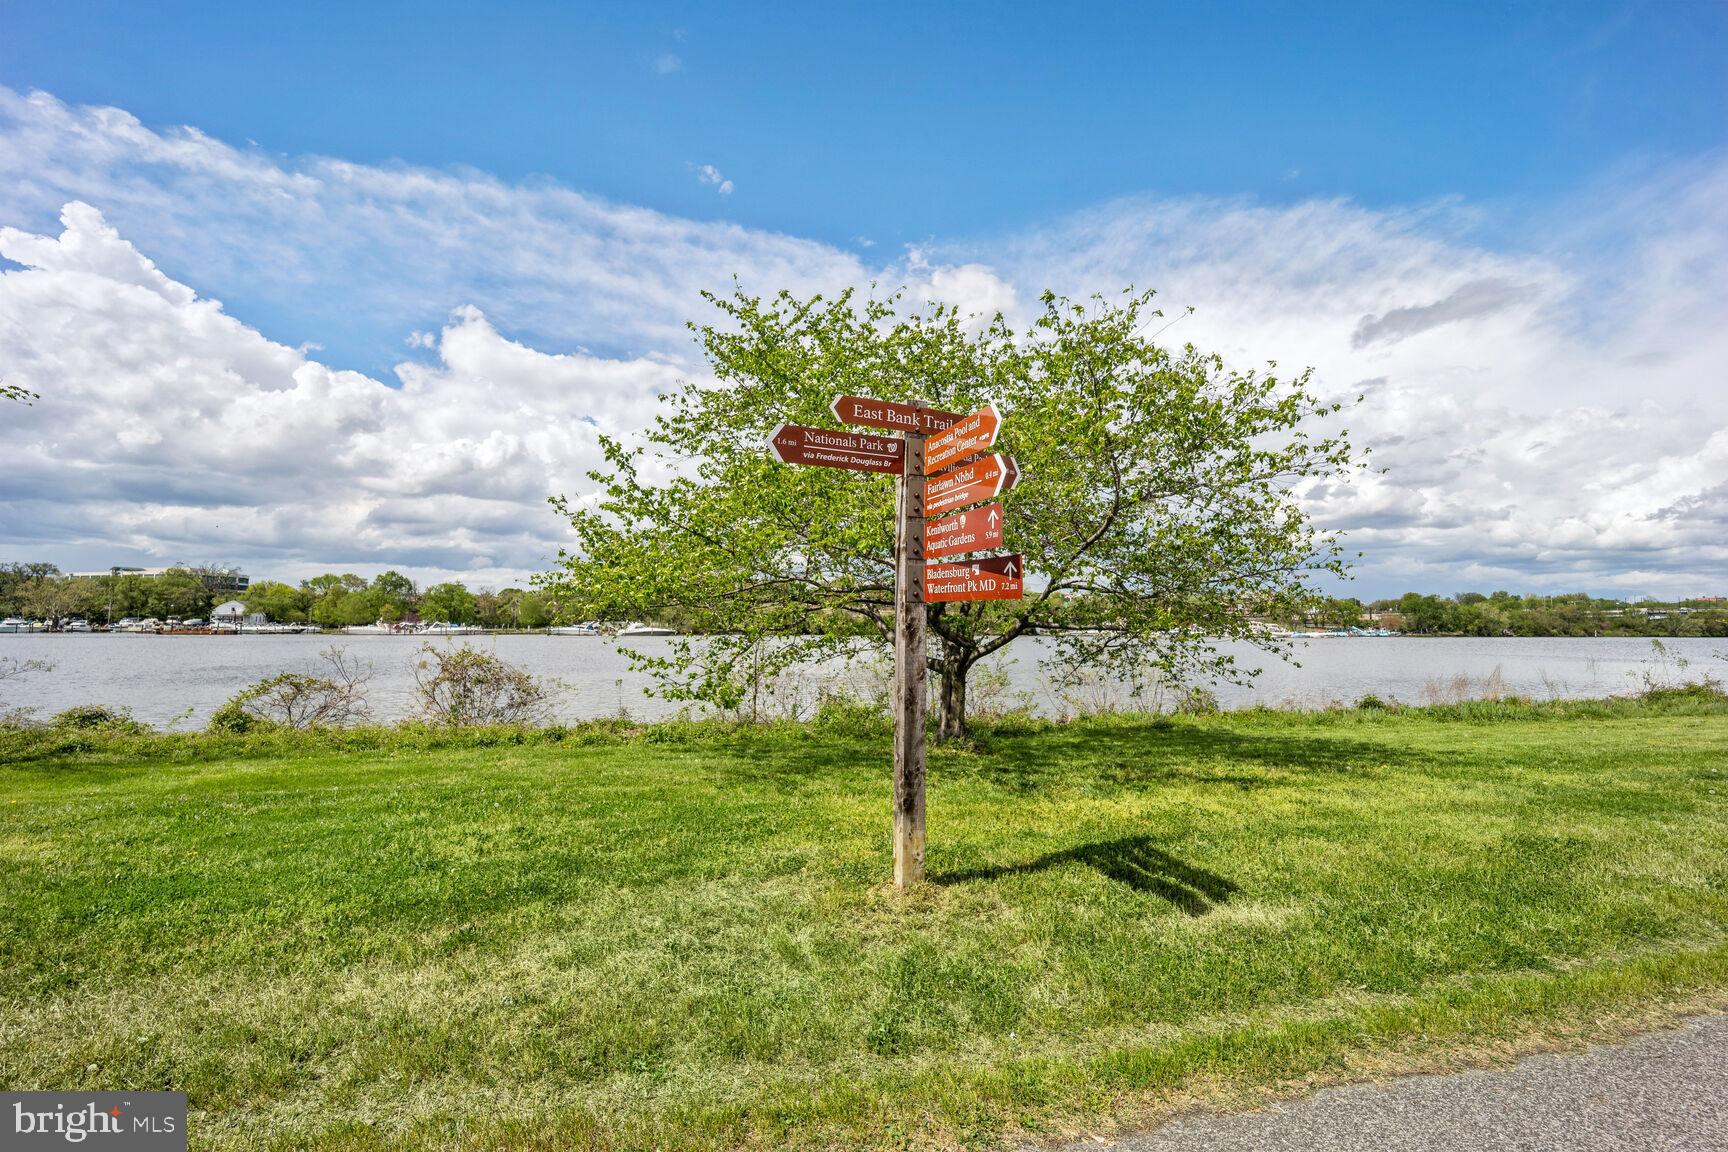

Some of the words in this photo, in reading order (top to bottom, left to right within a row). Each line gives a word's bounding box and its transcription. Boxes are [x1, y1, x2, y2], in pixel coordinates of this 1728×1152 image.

[853, 404, 882, 421] East
[886, 408, 921, 426] Bank
[924, 414, 953, 430] Trail
[804, 431, 856, 448] Nationals
[860, 438, 884, 451] Park
[928, 432, 954, 452] Anacostia
[954, 426, 968, 440] Pool
[968, 416, 980, 430] and
[928, 446, 956, 466] Recreation
[956, 435, 978, 452] Center
[816, 453, 850, 463] Frederick
[850, 456, 882, 466] Douglass
[992, 468, 998, 477] mi
[928, 478, 954, 494] Fairlawn
[954, 468, 974, 484] Nbhd
[932, 496, 954, 510] pedestrian
[926, 518, 958, 536] Kenilworth
[992, 530, 998, 538] mi
[927, 537, 948, 553] Aquatic
[948, 532, 976, 547] Gardens
[927, 566, 970, 580] Bladensburg
[927, 582, 966, 594] Waterfront
[968, 580, 978, 592] Pk
[980, 579, 996, 592] MD
[1001, 582, 1010, 590] 7.2
[1010, 582, 1018, 590] mi
